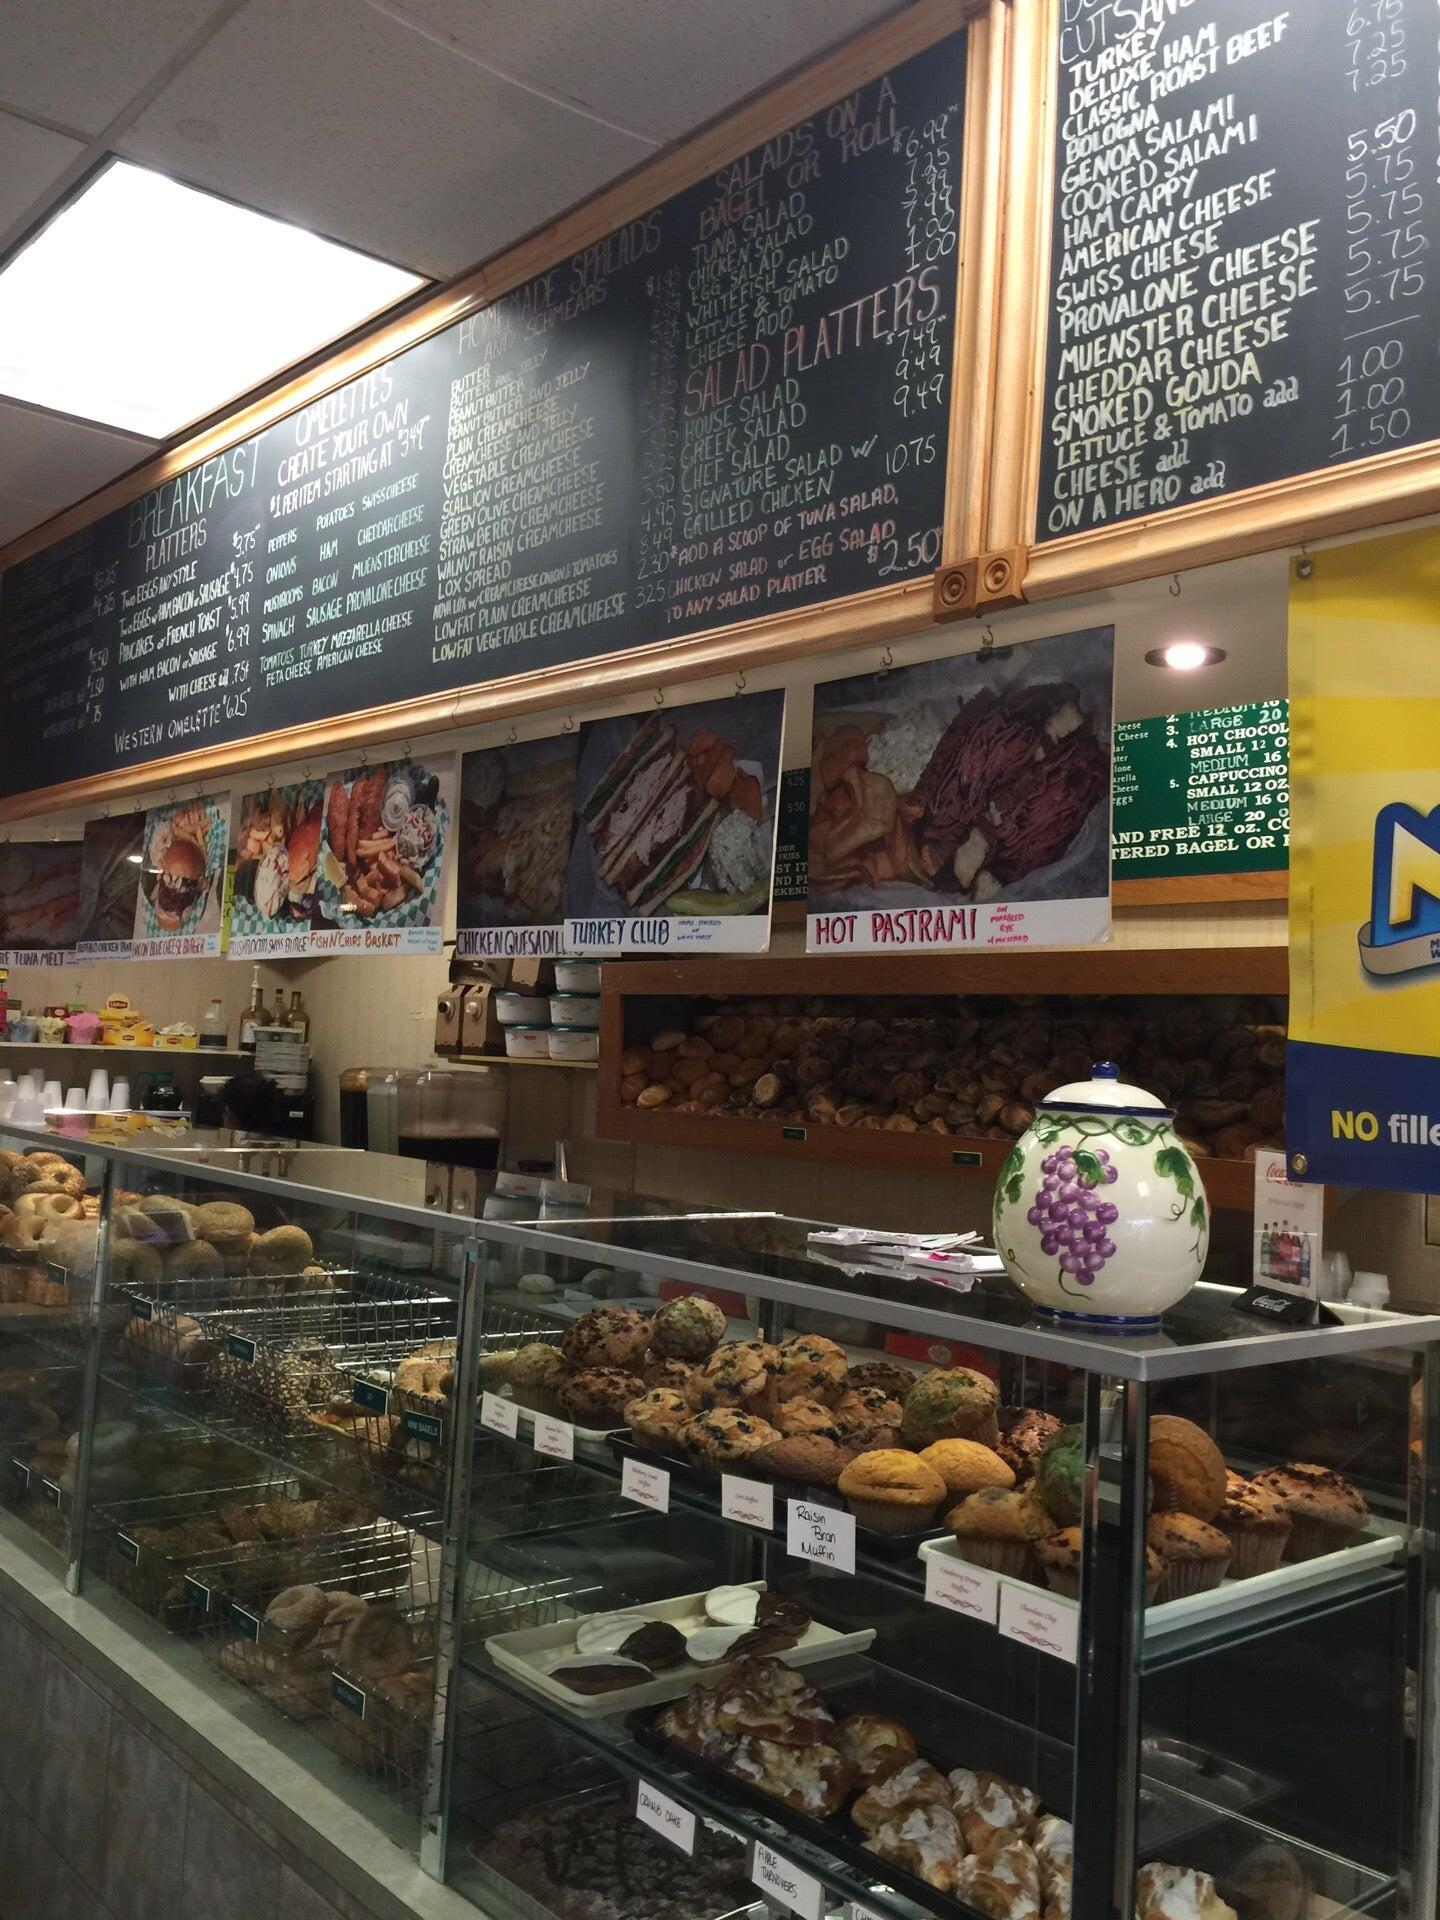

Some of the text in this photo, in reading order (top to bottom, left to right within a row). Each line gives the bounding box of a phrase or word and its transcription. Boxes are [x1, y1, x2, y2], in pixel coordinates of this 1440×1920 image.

[1060, 4, 1113, 64] CUT
[1069, 21, 1165, 87] TURKEY
[1345, 19, 1406, 66] 7.25
[1062, 88, 1141, 141] CLASSIC
[1150, 46, 1220, 101] ROAST
[1225, 12, 1290, 65] BEEF
[1069, 22, 1217, 115] DELUXE HAM
[1345, 49, 1407, 93] 7.25
[1061, 94, 1235, 194] GENOA SALAMI
[1066, 103, 1160, 165] BOLOGNA
[1347, 108, 1416, 162] 5.50
[1061, 114, 1258, 221] COOKED SALAMI
[1345, 146, 1414, 200] 5.75
[743, 192, 805, 237] SALAD
[1059, 168, 1276, 281] AMERICAN CHEESE
[1063, 168, 1198, 249] HAM CAPPY
[1346, 182, 1423, 236] 5.75
[755, 215, 813, 257] SALAD
[1345, 220, 1424, 277] 5.75
[731, 250, 783, 286] SALAD
[787, 237, 848, 282] SALAD
[1056, 219, 1224, 312] SWISS CHEESE
[1060, 218, 1321, 343] PROVALONE CHEESE
[1344, 261, 1425, 314] 5.75
[684, 345, 769, 416] SALAD
[785, 266, 939, 376] PLATTERS
[1059, 259, 1318, 380] MUENSTER CHEESE
[451, 363, 490, 397] BUTTER
[1055, 307, 1292, 411] CHEDDAR CHEESE
[1336, 340, 1404, 387] 1.00
[296, 361, 394, 447] OMELETTES
[686, 380, 799, 444] HOUSE SALAD
[1051, 351, 1262, 446] SMOKED GOUDA
[1334, 376, 1405, 420] 1.00
[278, 399, 408, 487] CREATE YOUR OWN
[446, 436, 473, 461] PLAIN
[517, 424, 539, 445] AND
[681, 403, 807, 471] GREEK SALAD
[1058, 392, 1253, 472] LETTUCE & TOMATO
[1328, 408, 1411, 458] 1.50
[299, 439, 394, 508] ITEM STARTING AT
[443, 455, 508, 498] VEGETABLE
[682, 435, 790, 493] CHEF SALAD
[886, 434, 936, 475] 10.75
[1054, 451, 1145, 501] CHEESE
[128, 431, 270, 549] BREAKFAST
[683, 444, 842, 516] SIGNATURE SALAD
[316, 501, 355, 531] POTATOES
[440, 498, 510, 540] GREEN OLIVE
[442, 487, 492, 520] SCALLION
[684, 471, 834, 540] GRILLED CHICKEN
[774, 504, 837, 538] OF TUNA
[1048, 473, 1182, 533] ON A HERO
[145, 518, 207, 573] PLATTERS
[319, 539, 339, 561] HAM
[440, 515, 518, 561] STRAWBERRY
[729, 518, 896, 581] SALAD EGG SALAD
[266, 556, 297, 584] ONIONS
[312, 569, 339, 596] BACON
[438, 540, 513, 581] WALNUT RAISIN
[438, 560, 510, 600] LOX SPREAD
[137, 576, 159, 604] EGGS
[685, 564, 827, 618] ANY SALAD PLATTER
[166, 606, 223, 647] FRENCH TOAST
[262, 615, 295, 644] SPINACH
[306, 597, 343, 628] SAUSAGE
[435, 602, 507, 641] LOWFAT PLAIN
[433, 619, 537, 664] LOWFAT VEGETABLE
[157, 654, 181, 679] BACON
[189, 672, 218, 696] CHEESE
[115, 703, 221, 754] WESTERN OMELETTE
[1258, 709, 1282, 724] 20
[1186, 732, 1220, 746] HOT
[1190, 742, 1246, 759] SMALL
[1188, 764, 1288, 786] CAPPUCCINO
[1190, 751, 1282, 774] MEDIUM 16
[1186, 784, 1239, 799] SMALL
[1243, 782, 1262, 793] 12
[1187, 794, 1272, 813] MEDIUM 16
[1149, 826, 1201, 842] FREE
[1187, 810, 1266, 827] LARGE 20
[1175, 836, 1276, 855] BAGEL OR
[310, 932, 328, 949] FISH
[339, 931, 361, 948] CHIPS
[365, 933, 401, 949] BASKET
[456, 930, 503, 955] CHICKEN
[571, 919, 626, 946] TURKEY
[631, 918, 670, 946] CLUB
[815, 915, 857, 945] HOT
[871, 907, 977, 944] PASTRAMI
[14, 951, 65, 966] TUNA MELT
[1331, 1110, 1379, 1141] NO
[418, 1422, 438, 1436] BAGELS
[795, 1505, 826, 1524] Raisin
[811, 1525, 836, 1544] Bran
[801, 1541, 836, 1562] Muffin
[761, 1866, 797, 1899] TURNOVERS
